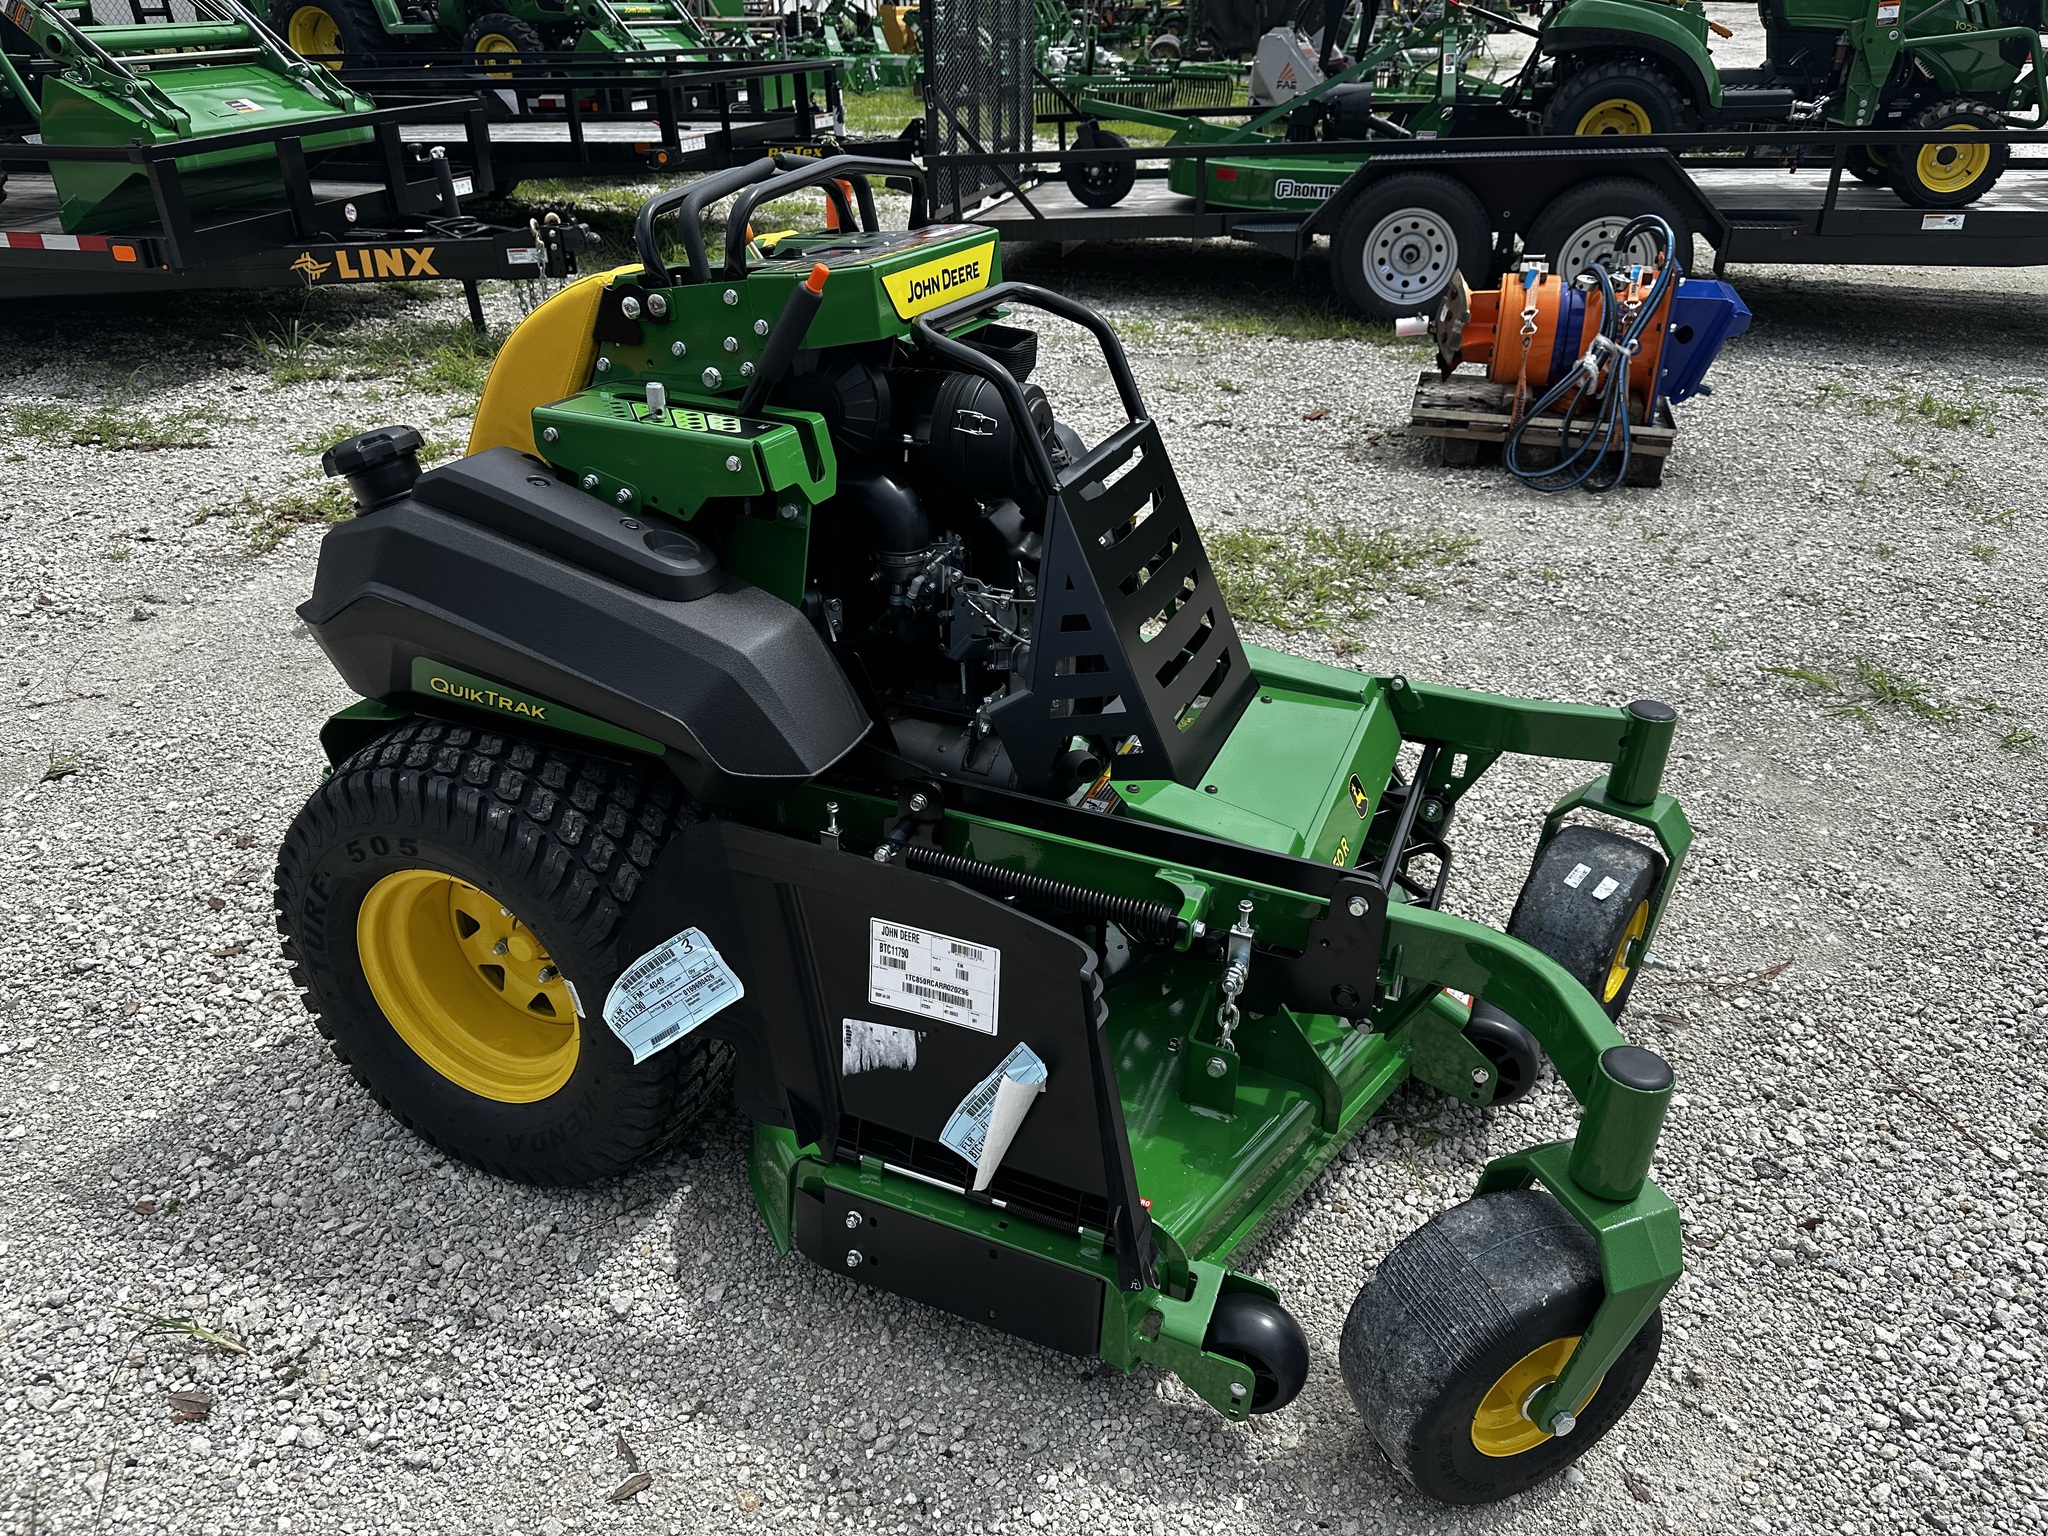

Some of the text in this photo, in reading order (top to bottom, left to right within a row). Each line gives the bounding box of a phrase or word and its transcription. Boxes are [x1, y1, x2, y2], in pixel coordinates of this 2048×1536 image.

[1276, 80, 1297, 90] FAE
[1276, 181, 1340, 199] FRONTIE
[335, 246, 440, 279] LINX
[907, 260, 980, 304] JOHN DEERE
[881, 925, 921, 945] JOHN DEERE
[680, 937, 694, 956] 3
[879, 942, 909, 959] BTC11790
[630, 990, 645, 1002] FM
[648, 976, 665, 991] 4049
[614, 1001, 647, 1030] BTC11790
[961, 1136, 976, 1151] FLR
